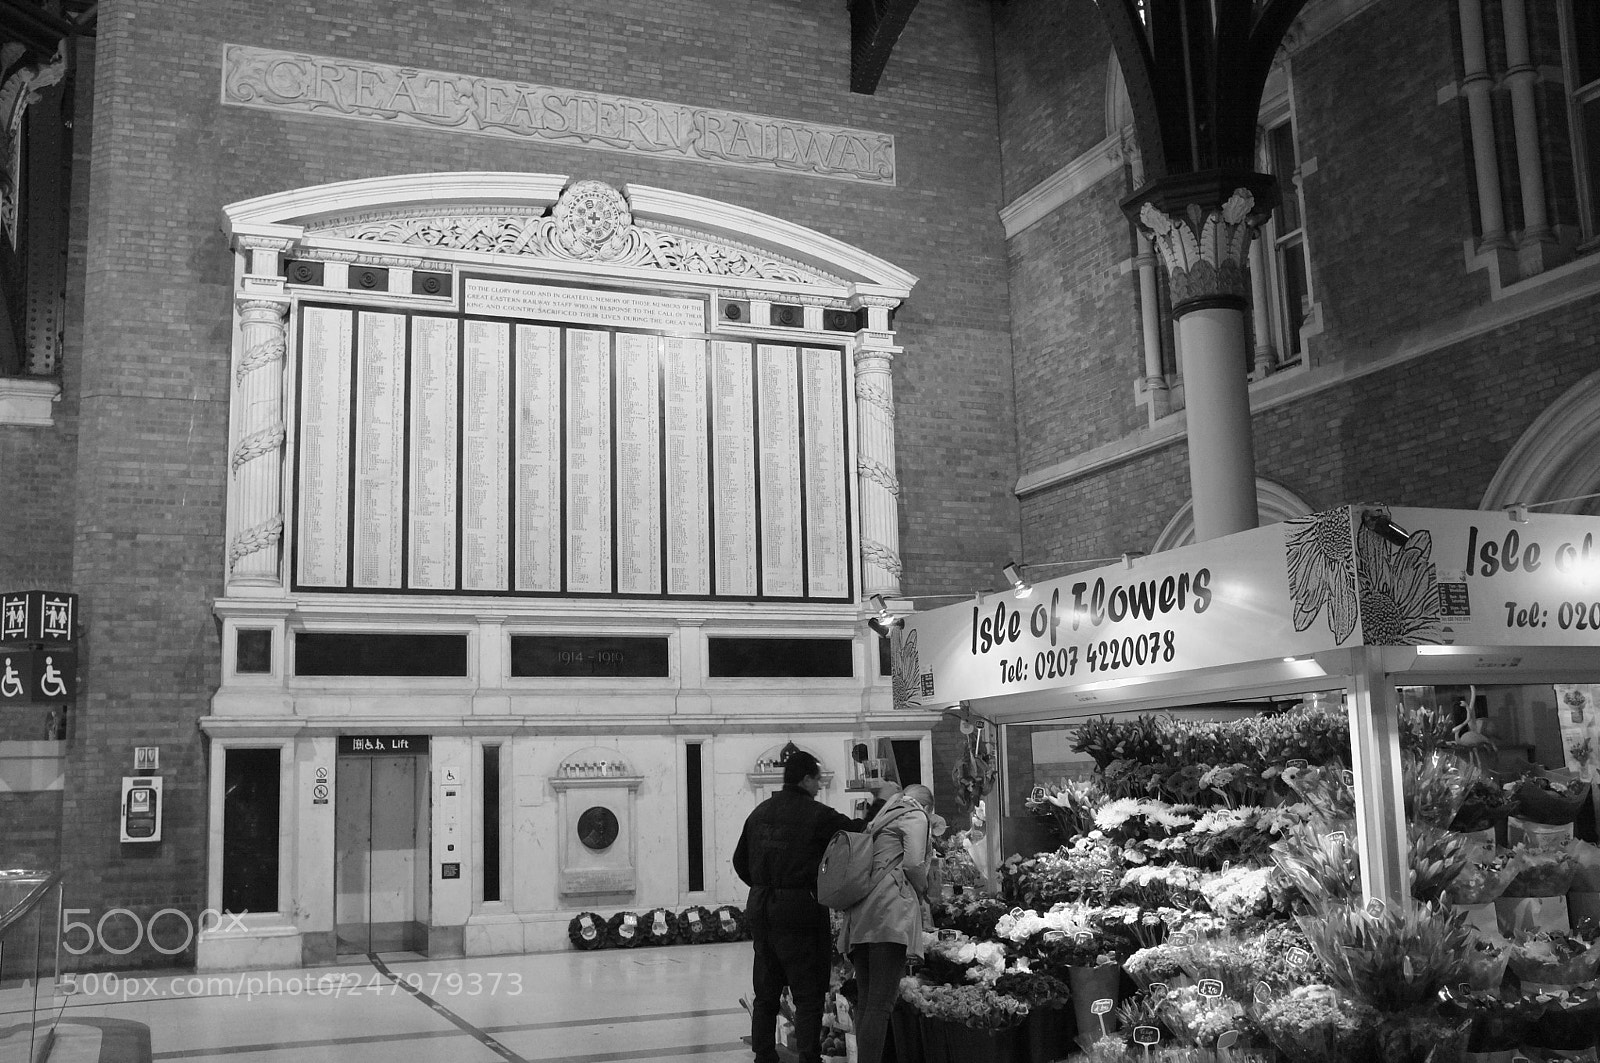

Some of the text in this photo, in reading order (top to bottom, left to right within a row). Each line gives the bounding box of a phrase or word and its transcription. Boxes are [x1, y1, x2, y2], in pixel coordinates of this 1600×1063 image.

[264, 58, 892, 175] GREAT EASTERN RAILWAY
[1466, 526, 1541, 577] Isle
[971, 567, 1213, 655] Isle of Flowers
[1505, 602, 1548, 628] Tel:
[1000, 630, 1176, 684] Tel: 0207 4220078
[392, 739, 409, 749] Lift
